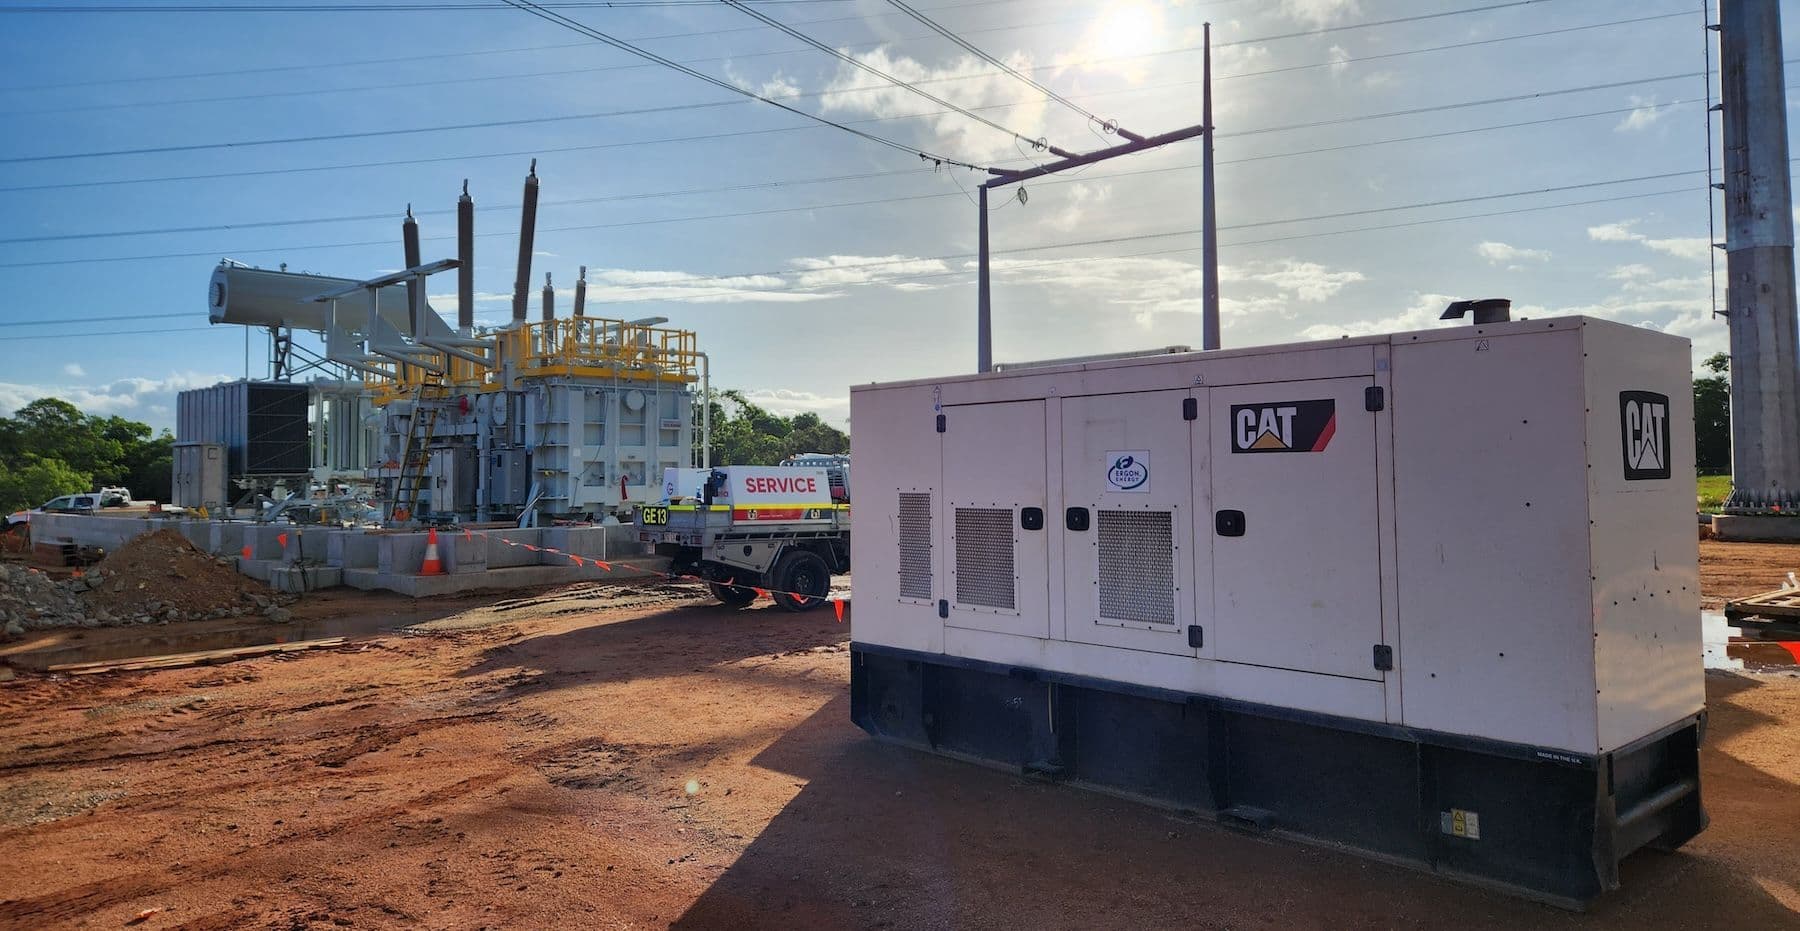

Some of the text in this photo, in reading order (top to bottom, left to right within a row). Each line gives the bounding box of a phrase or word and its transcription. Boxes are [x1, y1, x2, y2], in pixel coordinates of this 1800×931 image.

[1236, 406, 1297, 450] CAT
[1625, 399, 1665, 470] CAT
[745, 477, 817, 494] SERVICE
[643, 507, 668, 525] GE13
